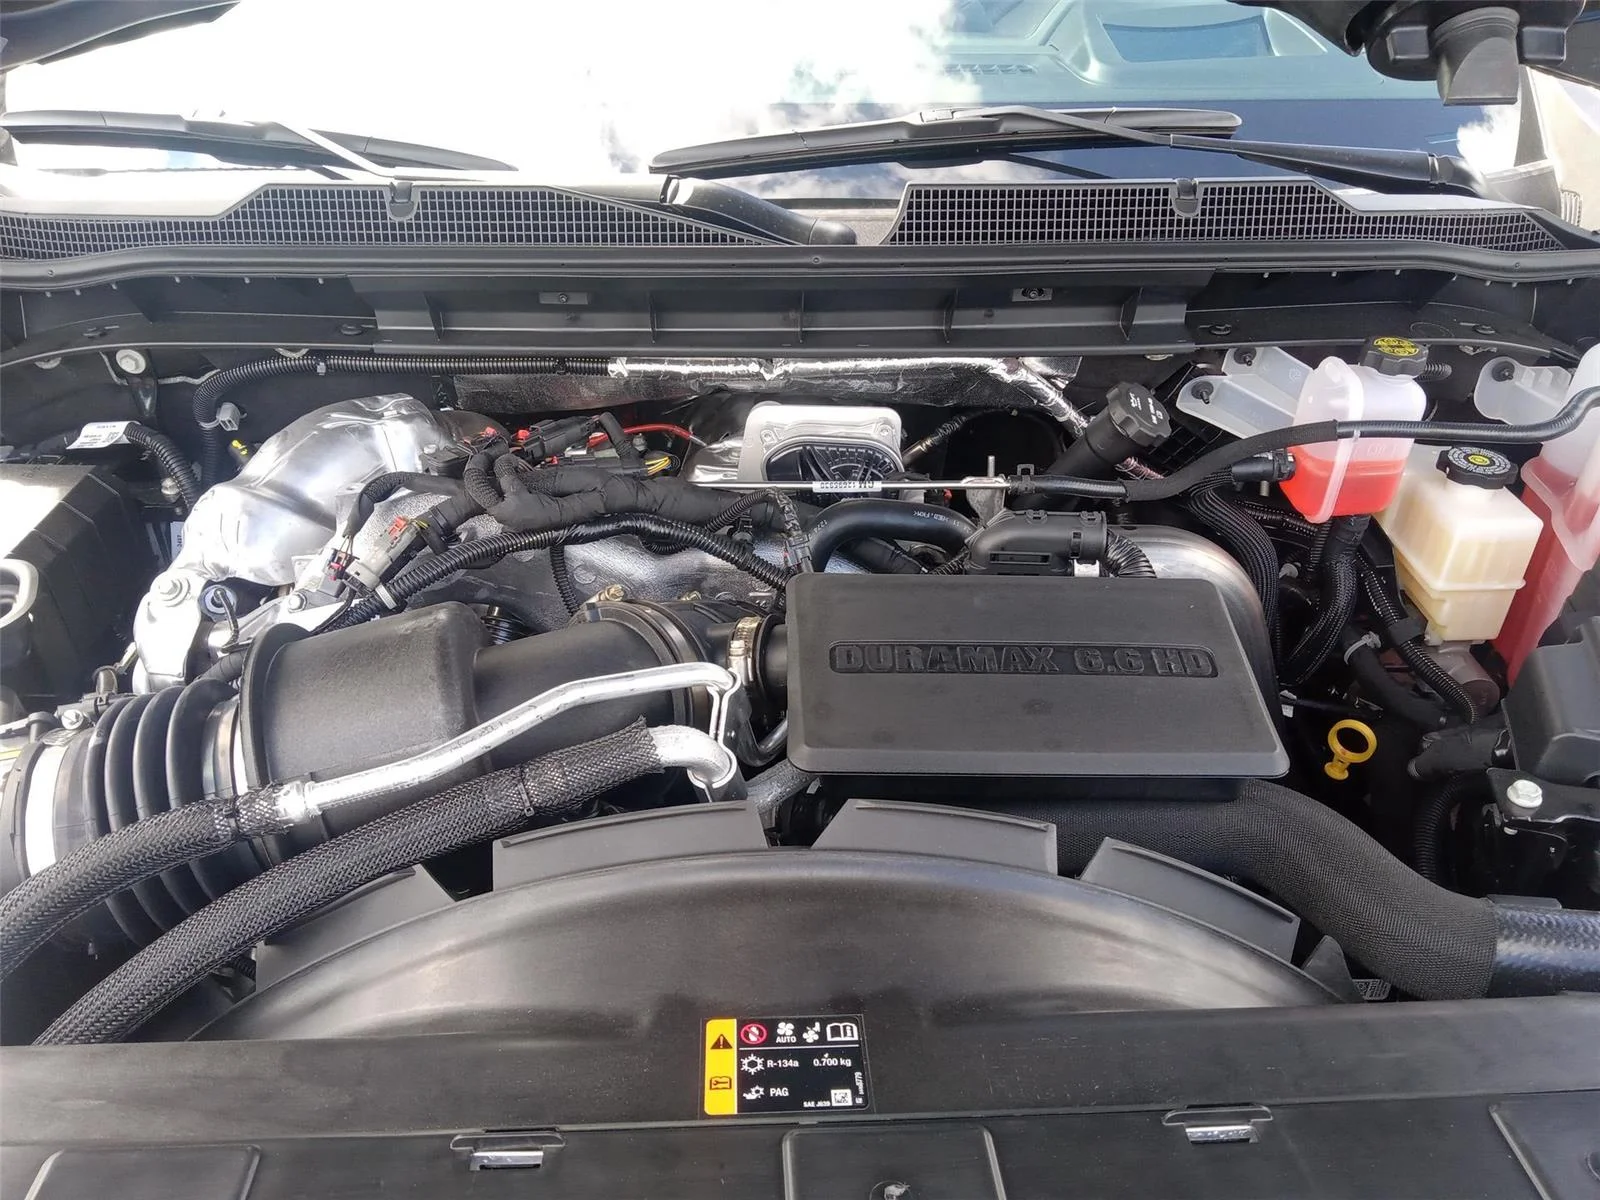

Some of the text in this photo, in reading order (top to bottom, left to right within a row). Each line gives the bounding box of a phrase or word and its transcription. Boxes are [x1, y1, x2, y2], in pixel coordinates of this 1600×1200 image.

[859, 480, 874, 489] GM
[835, 645, 1213, 676] DURAMAX 6.6 HD
[775, 1036, 797, 1044] AUTO
[766, 1057, 852, 1068] R-134a 0.700 kg
[769, 1087, 789, 1097] PAG
